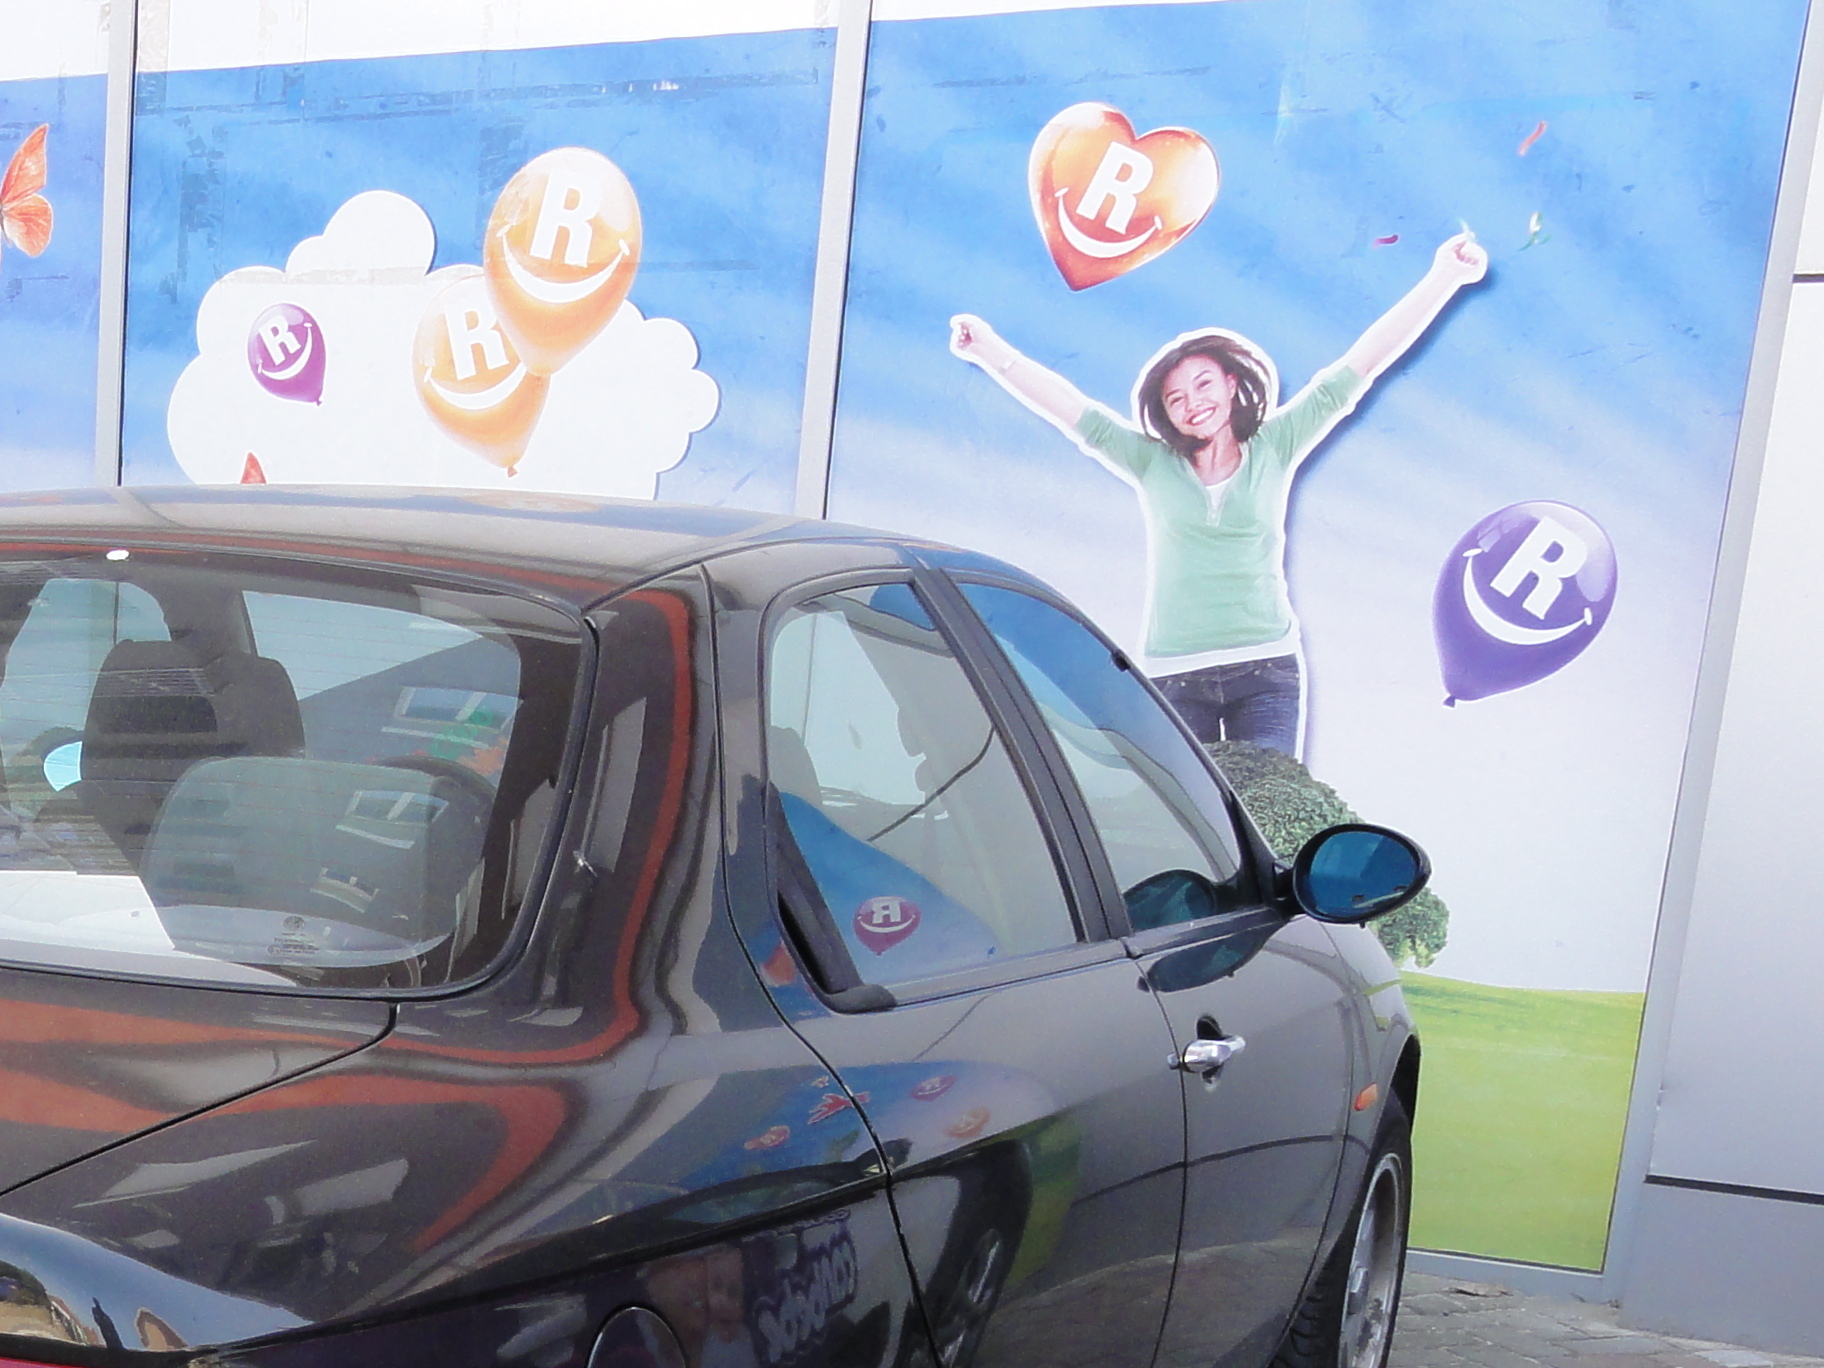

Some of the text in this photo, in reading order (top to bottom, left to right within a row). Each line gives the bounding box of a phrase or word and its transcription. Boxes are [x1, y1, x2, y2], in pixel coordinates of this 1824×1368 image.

[529, 169, 604, 268] R
[1076, 142, 1155, 235] R
[257, 315, 301, 366] R
[1490, 515, 1588, 620] R
